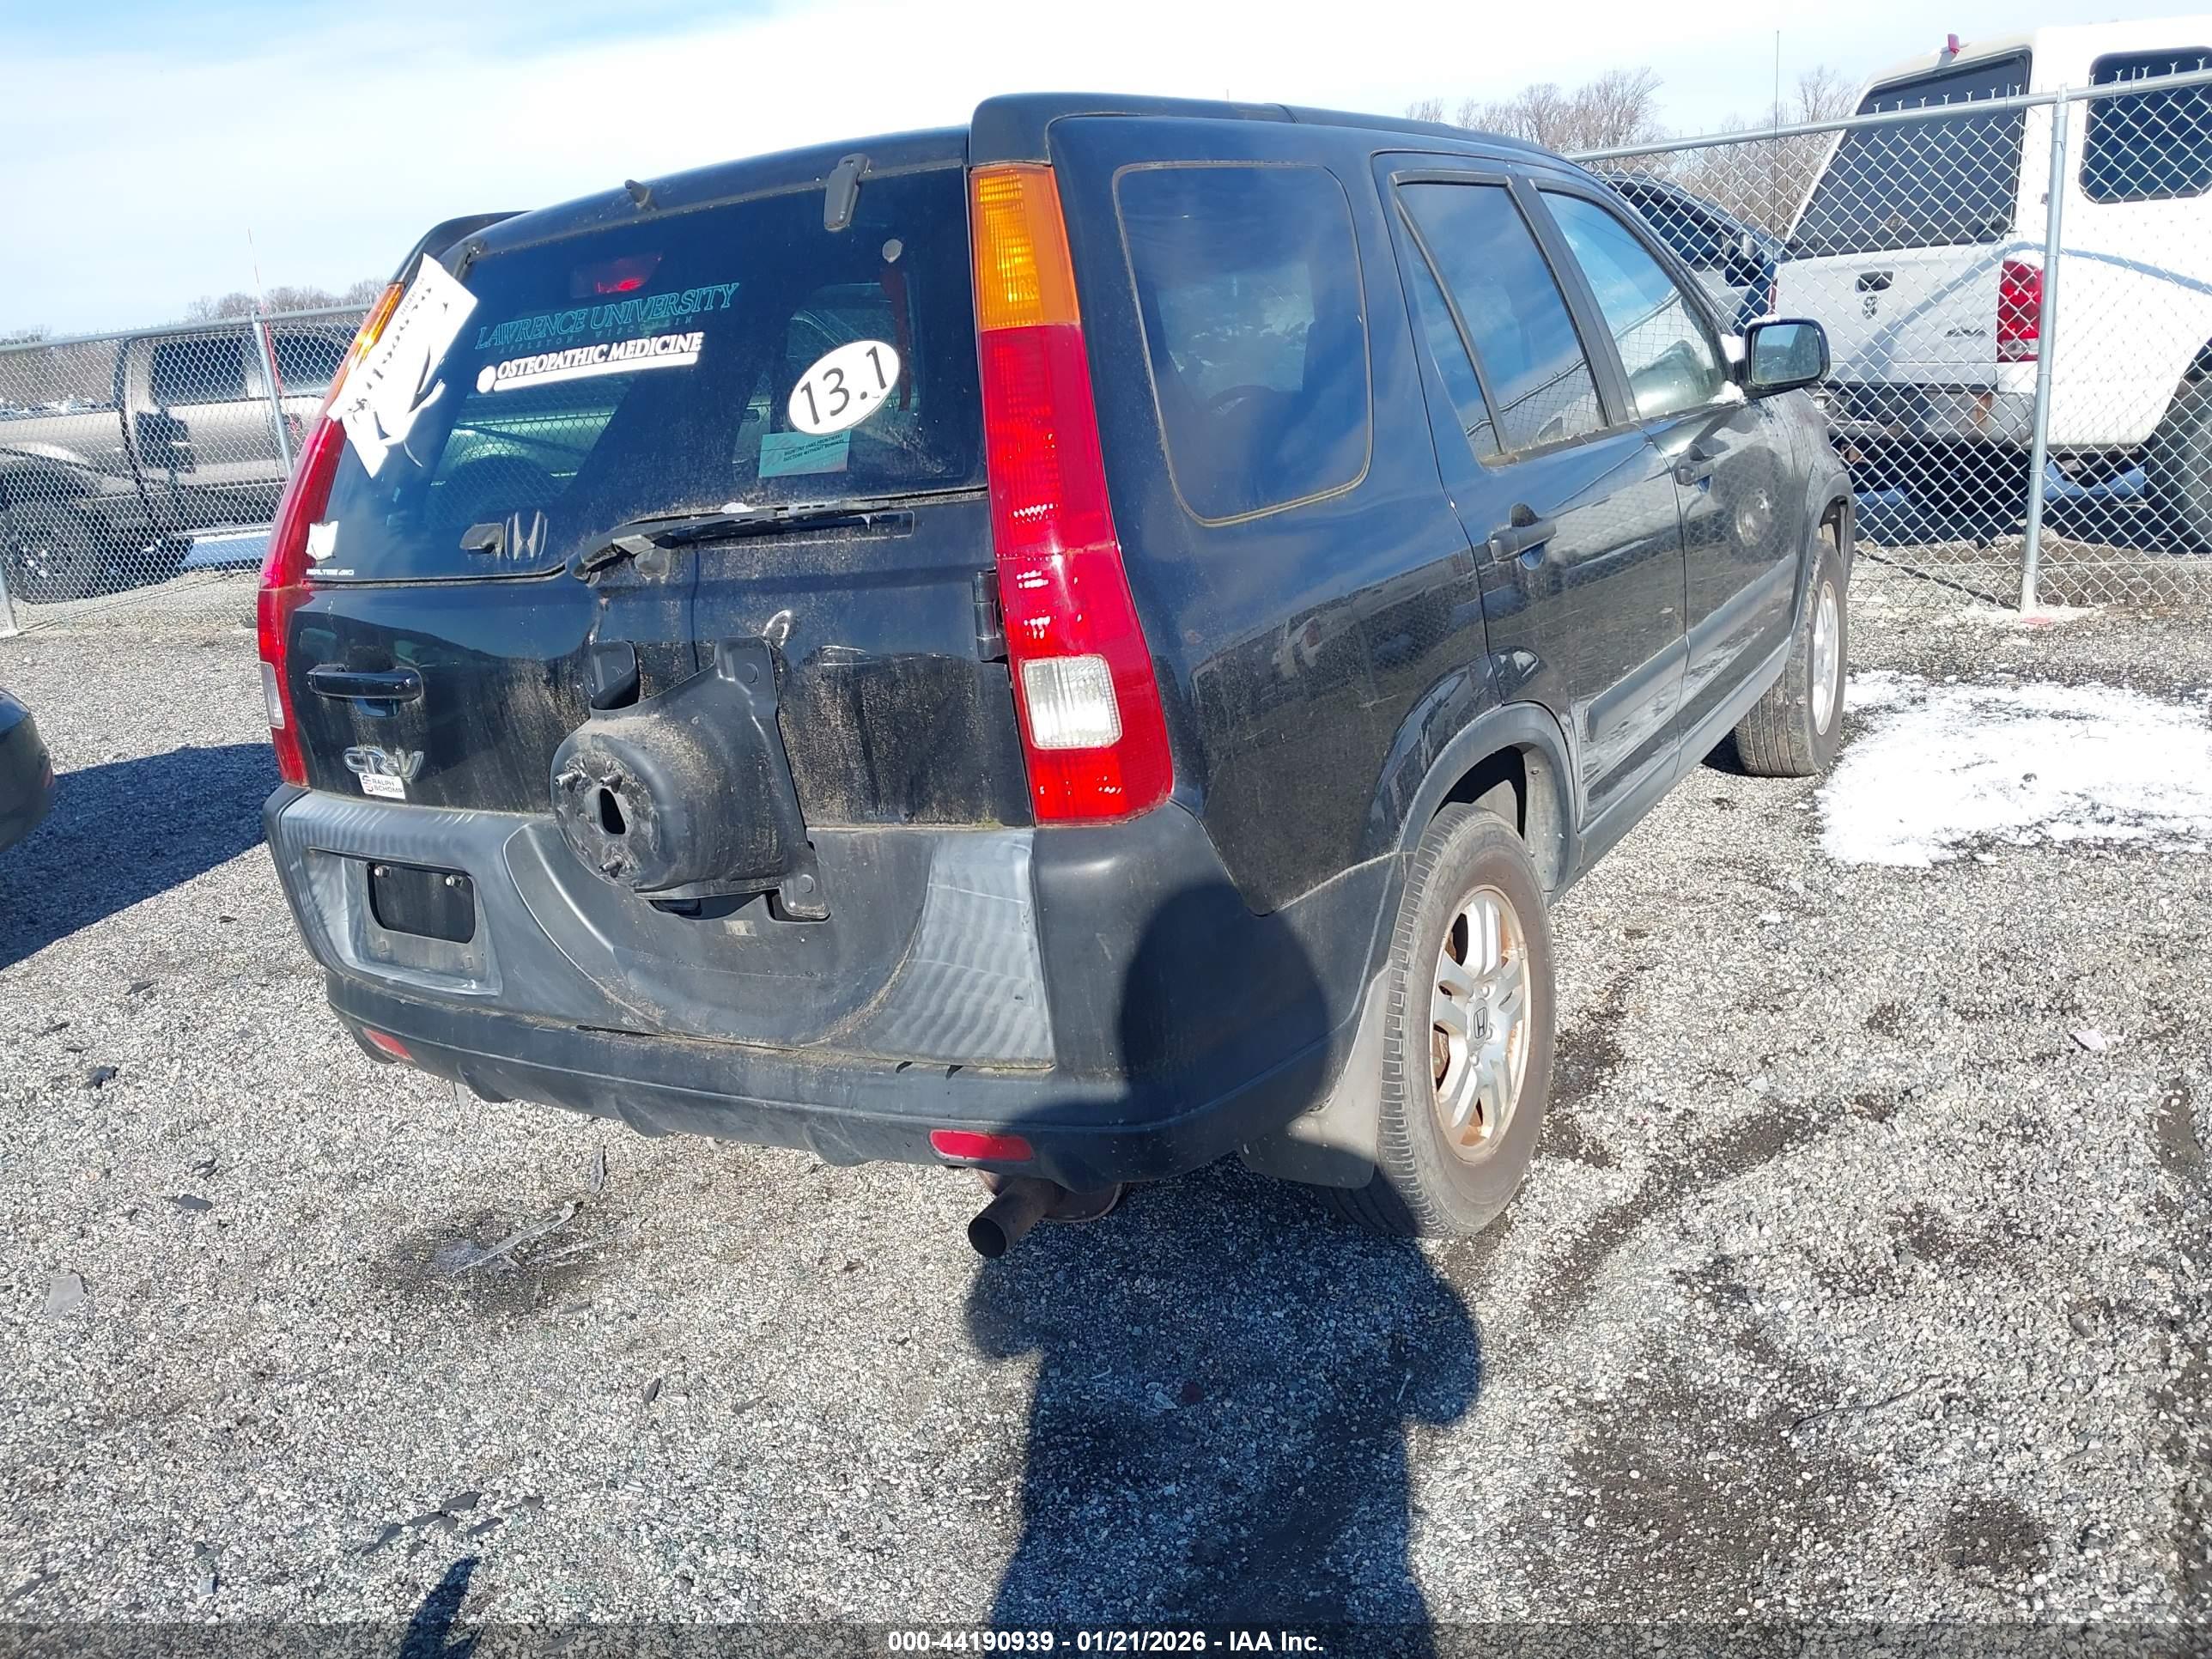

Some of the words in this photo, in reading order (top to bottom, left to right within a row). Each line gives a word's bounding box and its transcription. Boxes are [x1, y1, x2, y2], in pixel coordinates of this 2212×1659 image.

[474, 308, 588, 349] LAWRENCE
[589, 283, 739, 330] UNIVERSITY
[496, 343, 609, 380] OSTEOPATHIC
[607, 331, 705, 362] MEDICINE
[799, 345, 888, 426] 13.1
[372, 777, 395, 787] RALPH
